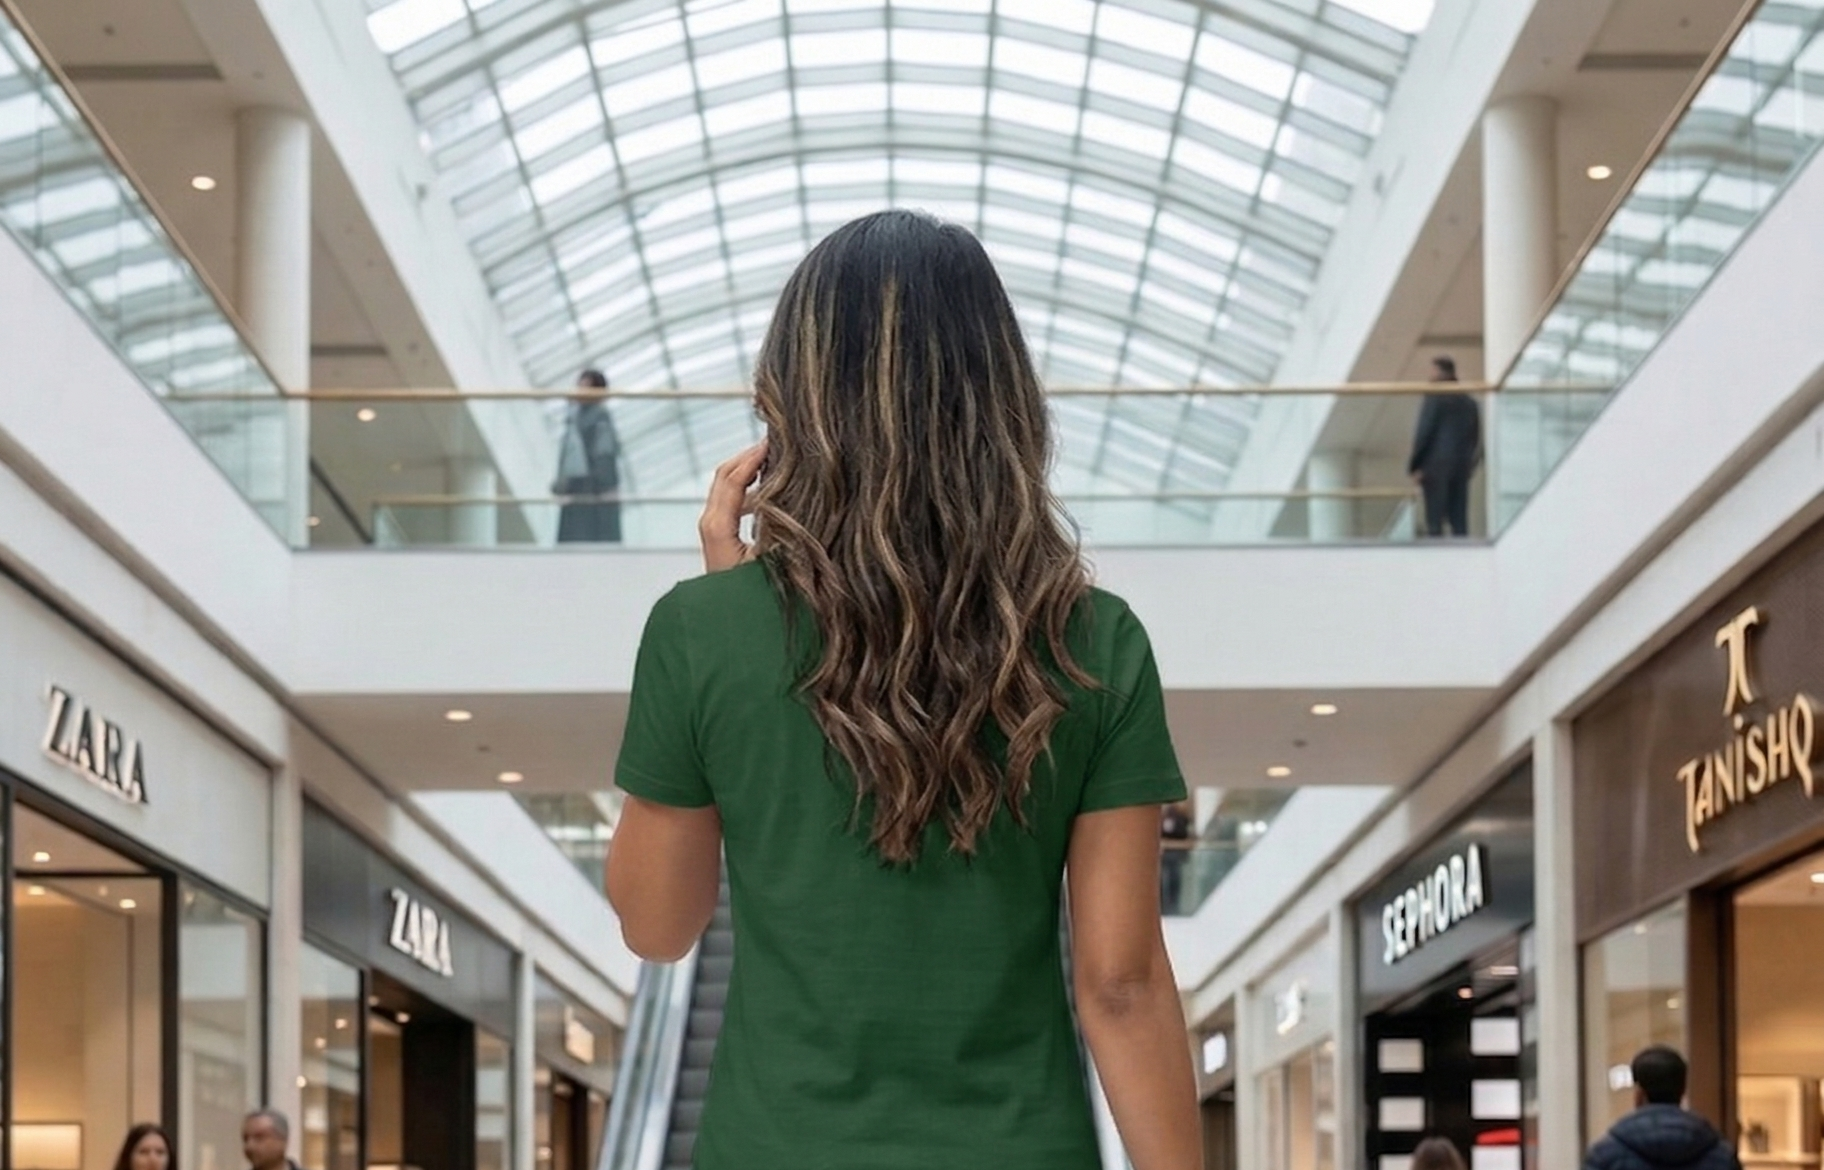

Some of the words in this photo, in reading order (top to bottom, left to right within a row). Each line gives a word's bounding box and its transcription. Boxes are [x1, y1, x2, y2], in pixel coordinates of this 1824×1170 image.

[43, 684, 148, 804] ZARA
[390, 887, 453, 977] ZARA
[1382, 842, 1483, 965] SEPHORA
